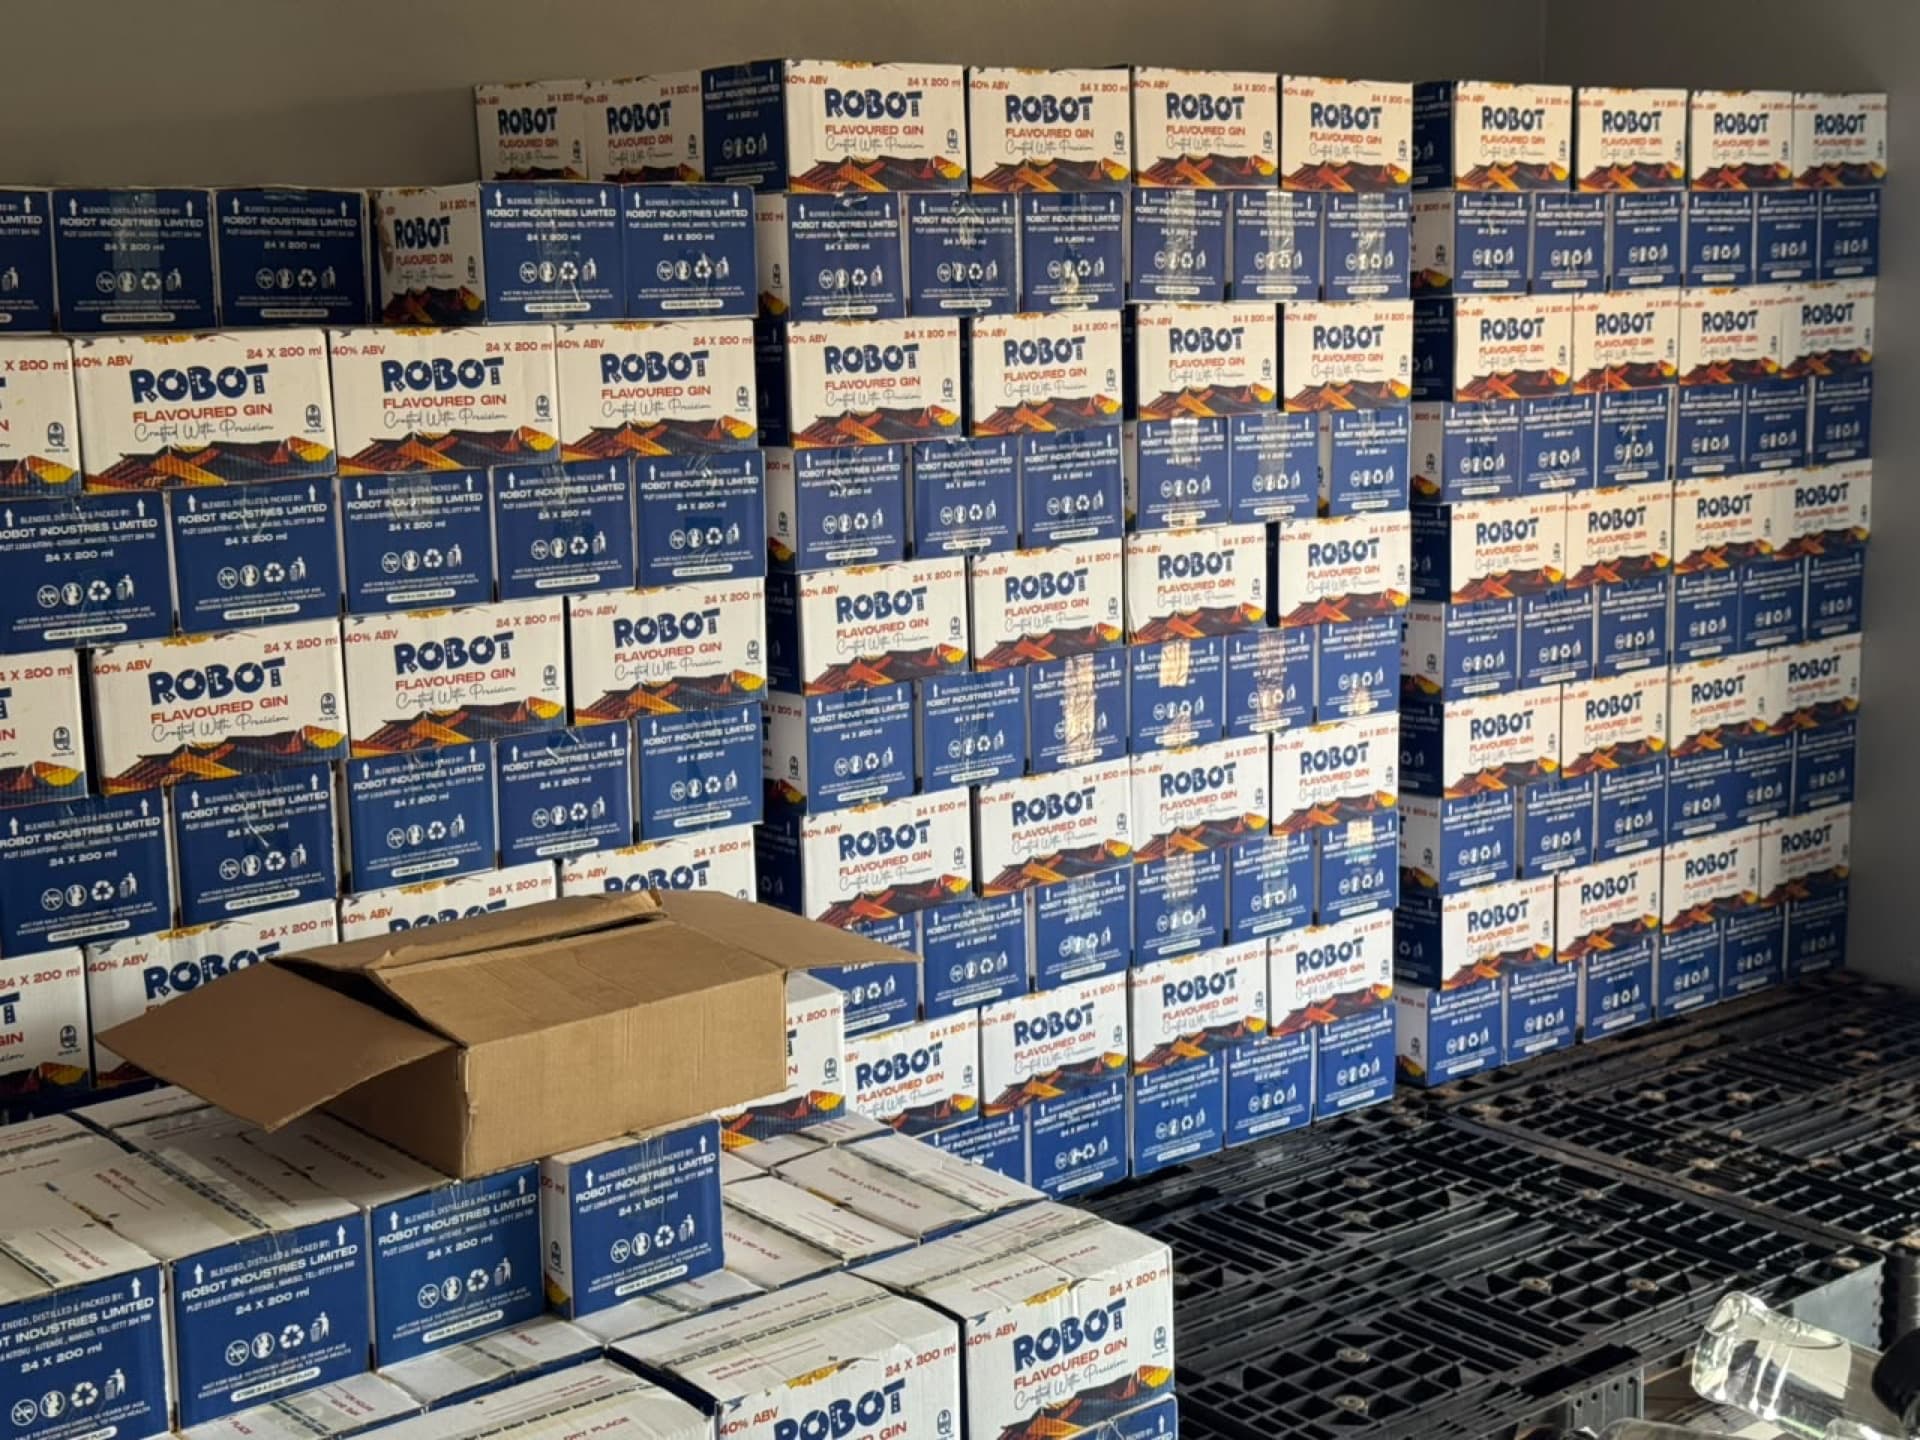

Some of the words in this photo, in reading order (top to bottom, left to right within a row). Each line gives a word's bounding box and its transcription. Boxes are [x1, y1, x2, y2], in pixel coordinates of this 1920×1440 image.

[824, 89, 922, 117] ROBOT
[1005, 95, 1092, 122] ROBOT
[1165, 93, 1244, 119] ROBOT
[1309, 103, 1381, 128] ROBOT
[497, 107, 556, 134] ROBOT
[606, 101, 669, 134] ROBOT
[825, 124, 898, 134] FLAVOURED
[903, 125, 923, 134] GIN
[1481, 106, 1544, 129] ROBOT
[1601, 110, 1661, 132] ROBOT
[1713, 113, 1768, 134] ROBOT
[1814, 114, 1866, 134] ROBOT
[1005, 128, 1071, 138] FLAVOURED
[1075, 128, 1093, 137] GIN
[392, 216, 449, 249] ROBOT
[1594, 311, 1654, 335] ROBOT
[1700, 310, 1757, 332] ROBOT
[1801, 302, 1854, 325] ROBOT
[1169, 326, 1244, 353] ROBOT
[1312, 325, 1383, 349] ROBOT
[1479, 317, 1544, 341] ROBOT
[267, 348, 275, 357] X
[279, 346, 304, 357] 200
[361, 347, 384, 356] ABV
[503, 342, 510, 351] X
[514, 341, 535, 351] 200
[824, 343, 918, 374] ROBOT
[1003, 336, 1085, 366] ROBOT
[381, 357, 503, 391] ROBOT
[600, 350, 708, 383] ROBOT
[1004, 368, 1065, 382] FLAVOURED
[1069, 367, 1086, 377] GIN
[129, 364, 268, 403] ROBOT
[601, 386, 682, 400] FLAVOURED
[688, 384, 710, 395] GIN
[824, 377, 895, 390] FLAVOURED
[900, 376, 920, 386] GIN
[132, 405, 237, 423] FLAVOURED
[243, 403, 272, 416] GIN
[382, 395, 474, 410] FLAVOURED
[480, 393, 506, 404] GIN
[1696, 493, 1752, 518] ROBOT
[1794, 482, 1848, 508] ROBOT
[1475, 517, 1538, 544] ROBOT
[1587, 505, 1646, 533] ROBOT
[1157, 549, 1234, 579] ROBOT
[1307, 537, 1379, 566] ROBOT
[1004, 568, 1088, 602] ROBOT
[835, 586, 927, 623] ROBOT
[1004, 600, 1067, 617] FLAVOURED
[1071, 597, 1088, 608] GIN
[514, 617, 520, 626] X
[524, 614, 545, 625] 200
[613, 608, 720, 647] ROBOT
[836, 620, 904, 639] FLAVOURED
[909, 617, 928, 628] GIN
[284, 641, 292, 650] X
[296, 637, 320, 649] 200
[375, 631, 397, 642] ABV
[126, 659, 152, 671] ABV
[394, 631, 513, 674] ROBOT
[614, 644, 694, 664] FLAVOURED
[699, 641, 721, 652] GIN
[148, 657, 285, 705] ROBOT
[395, 670, 485, 692] FLAVOURED
[491, 666, 515, 679] GIN
[1787, 655, 1840, 683] ROBOT
[1690, 674, 1744, 704] ROBOT
[150, 699, 253, 724] FLAVOURED
[260, 694, 288, 709] GIN
[1585, 690, 1642, 721] ROBOT
[1469, 709, 1533, 740] ROBOT
[1299, 741, 1368, 774] ROBOT
[1159, 761, 1236, 798] ROBOT
[1011, 786, 1095, 827] ROBOT
[838, 818, 930, 861] ROBOT
[1781, 824, 1831, 855] ROBOT
[604, 860, 710, 892] ROBOT
[1684, 848, 1737, 880] ROBOT
[1580, 870, 1637, 905] ROBOT
[280, 926, 287, 935] X
[292, 920, 316, 933] 200
[1467, 898, 1529, 933] ROBOT
[1295, 936, 1363, 975] ROBOT
[1162, 967, 1237, 1008] ROBOT
[1014, 1001, 1094, 1047] ROBOT
[856, 1041, 943, 1090] ROBOT
[576, 1184, 611, 1203] ROBOT
[615, 1165, 675, 1190] INDUSTRIES
[678, 1152, 716, 1171] LIMITED
[181, 1279, 227, 1301] ROBOT
[230, 1258, 306, 1287] INDUSTRIES
[309, 1244, 358, 1265] LIMITED
[1126, 1279, 1132, 1290] X
[1136, 1270, 1156, 1287] 200
[33, 1305, 73, 1323] DISTILLED
[80, 1295, 110, 1311] PACKED
[234, 1302, 252, 1315] 24
[254, 1299, 264, 1309] X
[266, 1291, 292, 1306] 200
[295, 1286, 310, 1298] ml
[15, 1313, 98, 1342] INDUSTRIES
[102, 1297, 154, 1319] LIMITED
[995, 1324, 1016, 1341] ABV
[1013, 1297, 1126, 1373] ROBOT
[21, 1360, 39, 1373] 24
[43, 1356, 52, 1367] X
[56, 1349, 83, 1363] 200
[87, 1342, 103, 1354] ml
[1014, 1347, 1098, 1392] FLAVOURED
[1104, 1336, 1127, 1356] GIN
[753, 1406, 778, 1425] ABV
[774, 1378, 905, 1440] ROBOT
[879, 1420, 907, 1440] GIN
